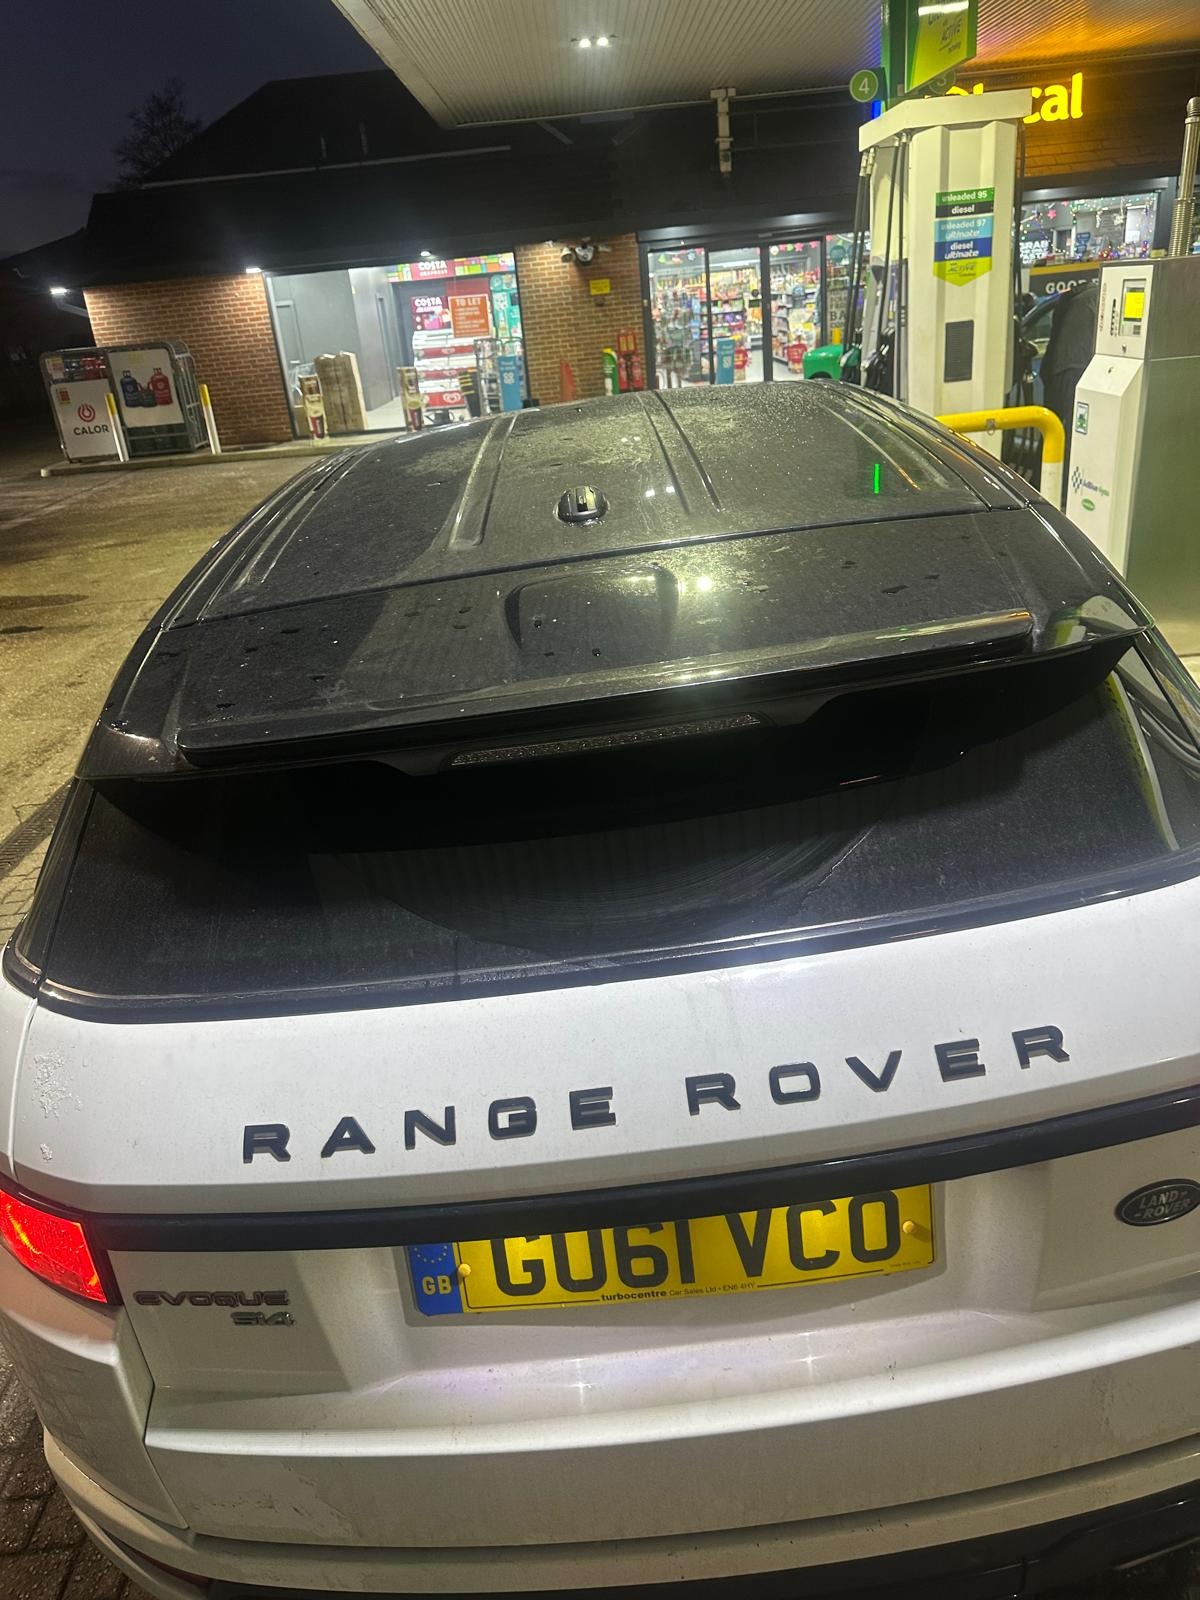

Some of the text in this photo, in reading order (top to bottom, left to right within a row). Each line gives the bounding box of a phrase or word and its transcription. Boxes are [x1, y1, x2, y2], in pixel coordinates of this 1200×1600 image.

[858, 77, 869, 94] 4
[977, 190, 988, 199] 95
[951, 204, 975, 214] diesel
[950, 241, 973, 250] diesel
[944, 250, 980, 260] ultimate
[418, 260, 448, 271] COSTA
[414, 296, 443, 307] COSTA
[456, 298, 467, 307] TO
[73, 424, 110, 436] CALOR
[242, 1024, 1070, 1164] RANGE ROVER
[1140, 1190, 1179, 1209] LAND
[1143, 1198, 1192, 1219] ROVER
[726, 1190, 901, 1278] VCO
[421, 1275, 452, 1297] GB
[601, 1290, 667, 1301] turbocentre
[669, 1289, 683, 1297] Car
[684, 1287, 704, 1296] Sales
[705, 1286, 717, 1294] Ltd
[133, 1290, 289, 1308] EVOQUE
[230, 1311, 296, 1327] Si4
